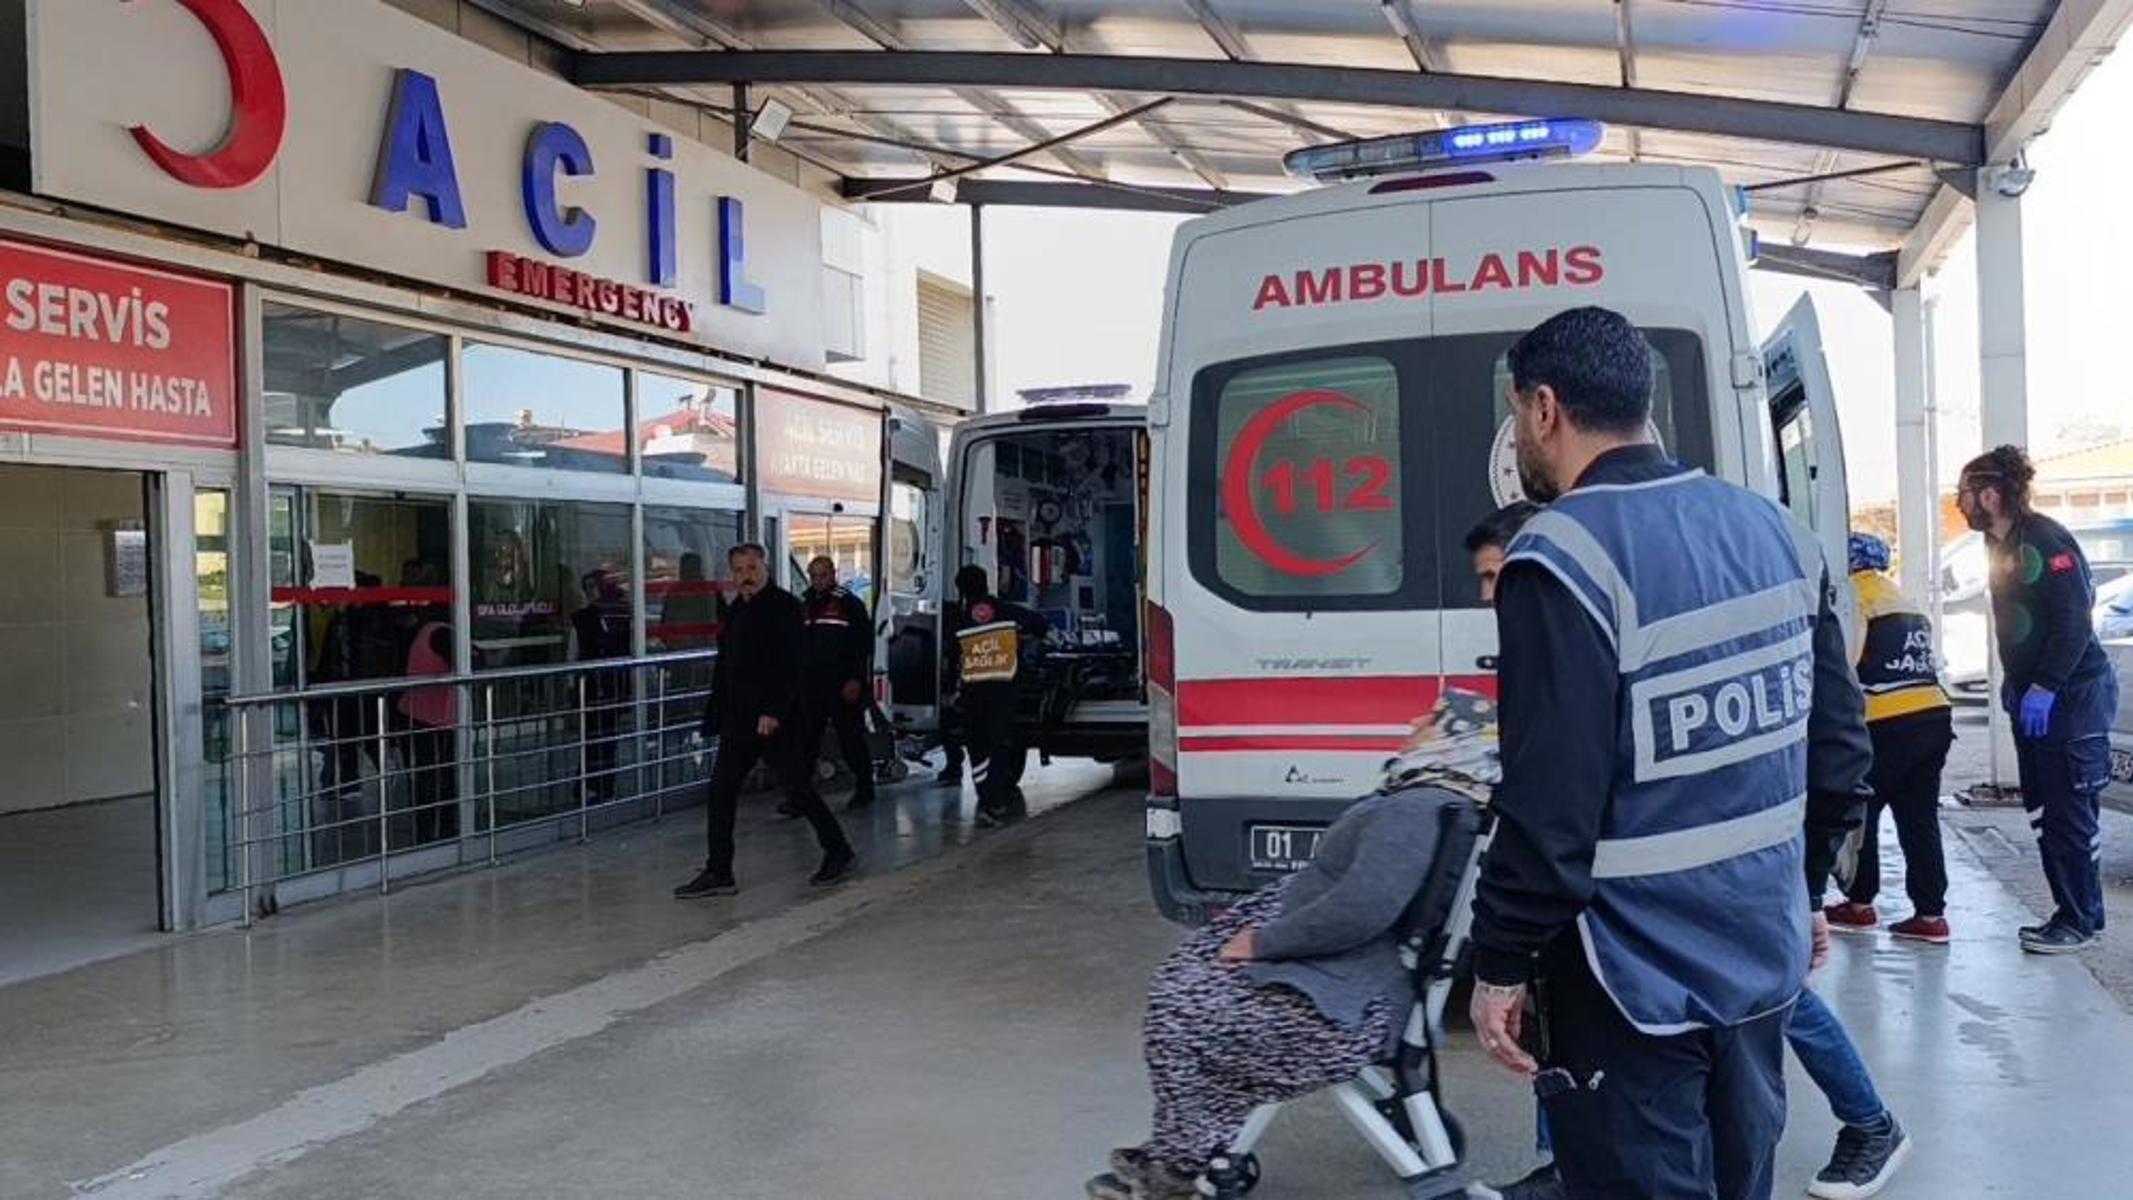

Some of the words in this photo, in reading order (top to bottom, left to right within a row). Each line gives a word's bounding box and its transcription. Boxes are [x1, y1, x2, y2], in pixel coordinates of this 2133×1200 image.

[370, 66, 767, 315] ACİL
[488, 251, 694, 333] EMERGENCY
[1252, 245, 1605, 311] AMBULANS
[6, 277, 171, 350] SERVİS
[0, 356, 26, 399] A
[33, 360, 123, 409] GELEN
[131, 371, 213, 418] HASTA
[1262, 456, 1396, 514] 112
[1669, 657, 1812, 752] POLİS
[1266, 831, 1292, 859] 01
